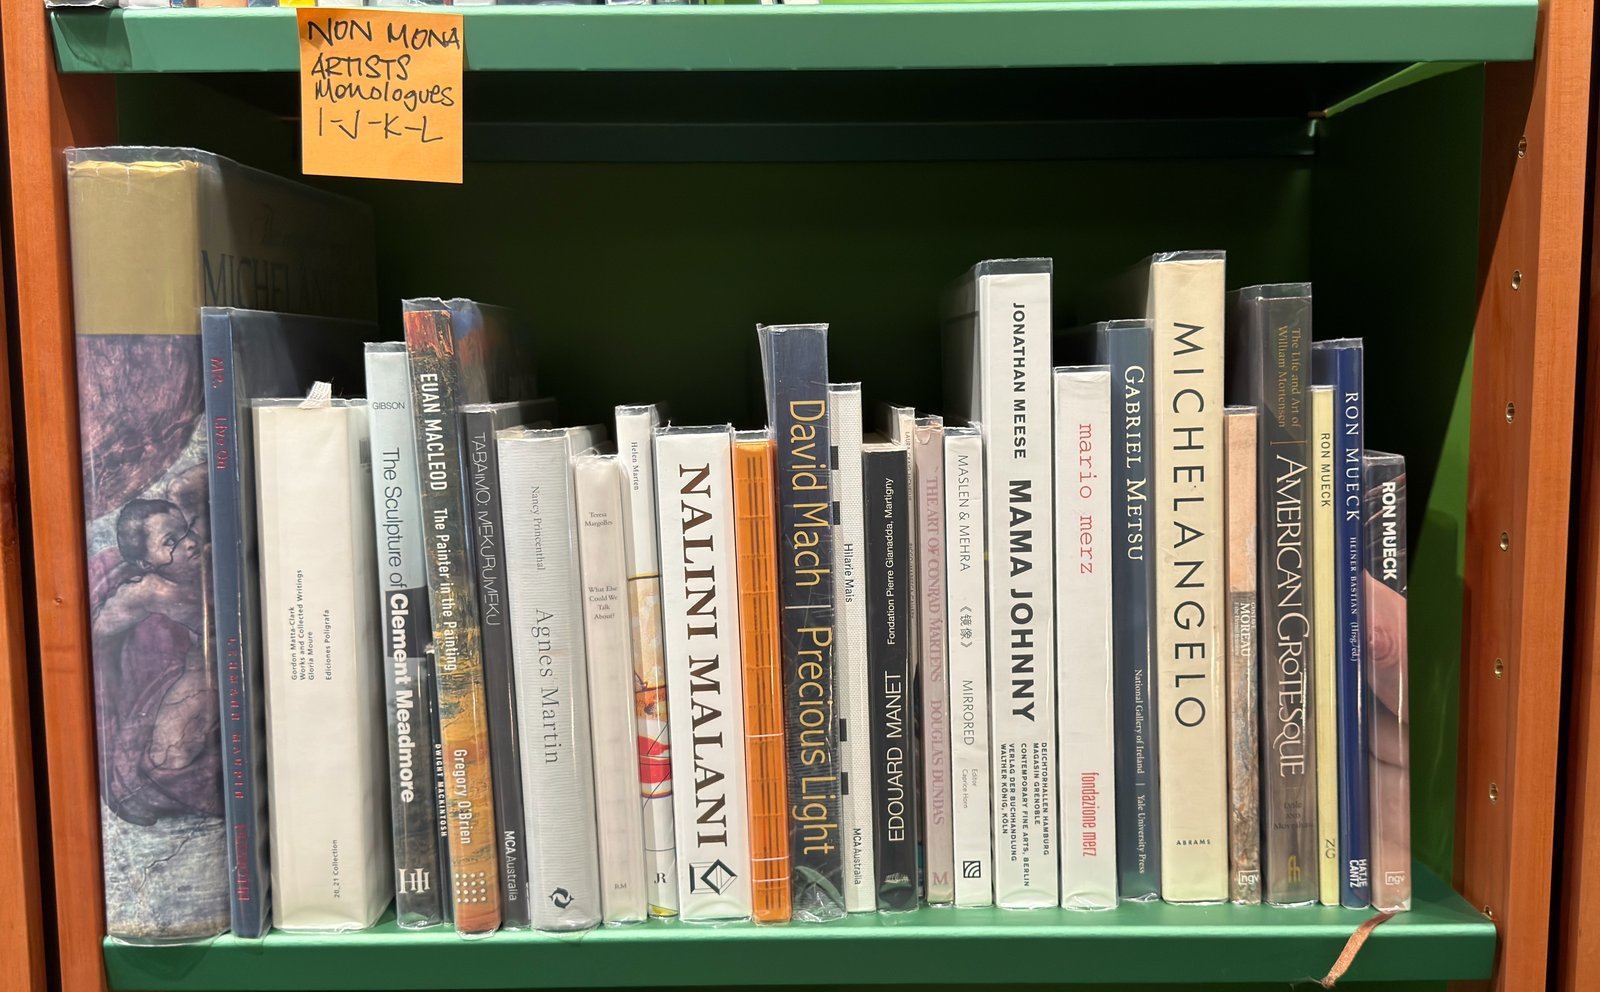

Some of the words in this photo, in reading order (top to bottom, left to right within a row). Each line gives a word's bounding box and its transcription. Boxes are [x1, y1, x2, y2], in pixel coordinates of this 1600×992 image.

[308, 18, 372, 46] NON
[387, 23, 460, 50] MONA
[311, 52, 411, 80] ARTISTS
[315, 78, 455, 112] Monologues
[1013, 303, 1026, 392] JONATHAN
[1278, 325, 1288, 368] William
[1291, 328, 1301, 348] The
[1291, 352, 1301, 371] Life
[420, 374, 441, 413] EUAN
[1278, 371, 1288, 428] Mortensen
[1291, 374, 1301, 394] and
[372, 402, 405, 410] GIBSON
[1125, 366, 1145, 468] GABRIEL
[1291, 398, 1300, 414] Art
[1292, 417, 1301, 428] of
[1345, 392, 1359, 435] RON
[789, 400, 828, 490] David
[1014, 400, 1026, 459] MEESE
[1321, 433, 1330, 458] RON
[383, 447, 400, 480] The
[424, 419, 448, 490] MACLEOD
[1079, 424, 1098, 499] mario
[632, 465, 640, 490] Marten
[884, 478, 894, 518] Martigny
[926, 476, 938, 505] THE
[958, 454, 970, 508] MASLEN
[1321, 464, 1330, 507] MUECK
[1345, 448, 1360, 522] MUECK
[433, 508, 448, 530] The
[530, 486, 540, 516] Nancy
[926, 509, 940, 534] ART
[958, 511, 970, 521] &
[1126, 478, 1147, 560] METSU
[1382, 482, 1396, 518] RON
[382, 486, 405, 567] Sculpture
[532, 518, 546, 571] Princenthal
[792, 502, 830, 586] Mach
[886, 520, 895, 568] Gianadda,
[1009, 480, 1032, 578] MAMA
[1080, 515, 1094, 574] merz
[1172, 322, 1206, 727] MICHELANGELO
[1276, 454, 1308, 607] AMERICAN
[436, 534, 452, 578] Painter
[478, 510, 500, 626] MEKURUMEKU
[679, 462, 718, 640] NALINI
[844, 543, 854, 576] Hilarie
[928, 537, 940, 556] OF
[958, 525, 971, 572] MEHRA
[1382, 522, 1397, 581] MUECK
[390, 572, 407, 588] of
[440, 582, 454, 594] in
[845, 578, 855, 603] Mais
[886, 570, 896, 596] Pierre
[928, 558, 940, 614] CONRAD
[288, 606, 296, 650] Matta-Clark
[442, 598, 455, 617] the
[886, 600, 896, 645] Fondation
[391, 593, 412, 684] Clement
[443, 621, 460, 672] Painting
[531, 608, 554, 678] Agnes
[929, 618, 942, 682] MARTENS
[1240, 602, 1250, 657] MOREAU
[1010, 588, 1035, 722] JOHNNY
[797, 626, 834, 766] Precious
[884, 670, 902, 738] MANET
[1134, 669, 1144, 704] National
[1273, 612, 1310, 777] GROTESQUE
[541, 687, 562, 764] Martin
[931, 700, 944, 766] DOUGLAS
[962, 680, 974, 746] MIRRORED
[1134, 705, 1144, 734] Gallery
[396, 690, 416, 803] Meadmore
[434, 744, 444, 777] DWIGHT
[688, 654, 728, 848] MALANI
[1136, 735, 1144, 744] of
[1136, 746, 1145, 774] Ireland
[452, 749, 468, 796] Gregory
[886, 746, 904, 841] EDOUARD
[437, 781, 448, 838] MACKINTOSH
[791, 776, 838, 855] Light
[932, 770, 944, 825] DUNDAS
[1081, 772, 1100, 828] fondazione
[1137, 794, 1146, 810] Yale
[458, 801, 473, 844] O'Brien
[504, 830, 516, 854] MCA
[853, 828, 862, 847] MCA
[1082, 832, 1097, 856] merz
[1137, 812, 1146, 851] University
[1176, 838, 1211, 846] ABRAMS
[854, 848, 862, 884] Australia
[1138, 854, 1147, 874] Press
[1325, 839, 1336, 859] ZG
[506, 855, 518, 900] Australia
[1241, 874, 1259, 884] ngv
[1349, 859, 1360, 888] CANTZ
[1359, 859, 1367, 887] HATJE
[1388, 875, 1405, 884] ngv
